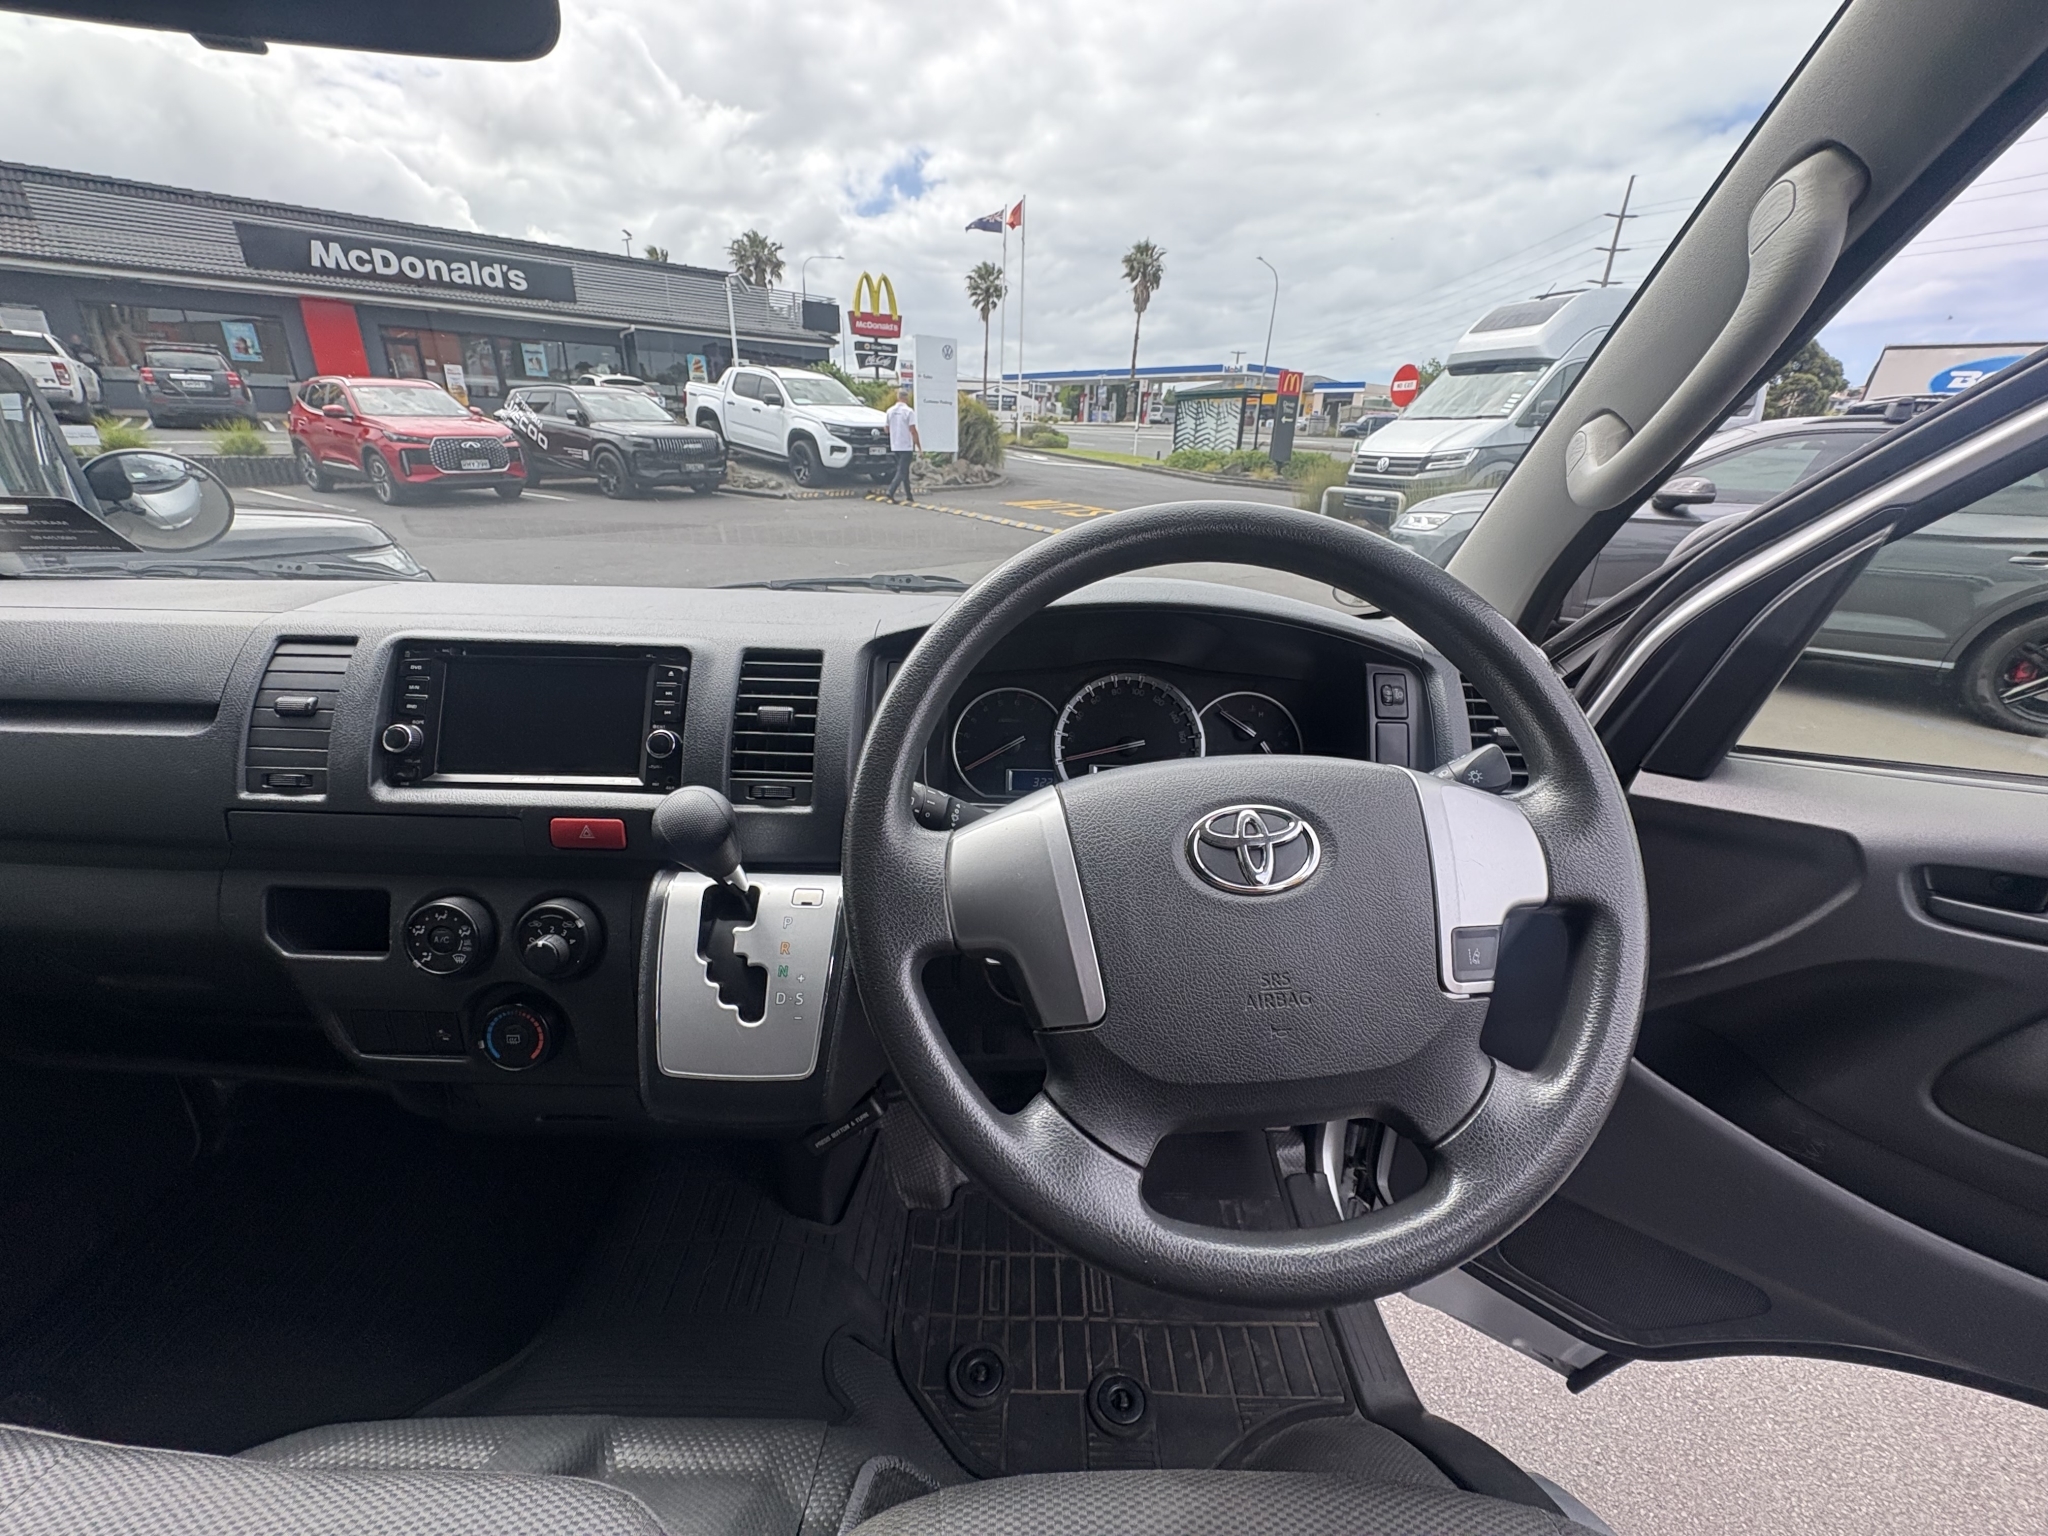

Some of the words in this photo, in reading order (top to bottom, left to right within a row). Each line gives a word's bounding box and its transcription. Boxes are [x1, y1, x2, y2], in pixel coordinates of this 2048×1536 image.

[310, 239, 529, 291] McDonald's
[855, 320, 899, 332] McDonald's
[1224, 365, 1244, 374] Mobil
[1404, 381, 1414, 389] EXIT
[549, 925, 556, 934] 2
[782, 916, 793, 930] P
[433, 936, 450, 944] A/C
[560, 929, 568, 938] 3
[780, 941, 791, 956] R
[777, 964, 788, 978] N
[1260, 971, 1292, 989] SRS
[775, 992, 786, 1005] D
[795, 992, 804, 1006] S
[1244, 990, 1313, 1011] AIRBAG
[830, 1123, 850, 1139] BUTTON
[855, 1111, 870, 1123] TURN
